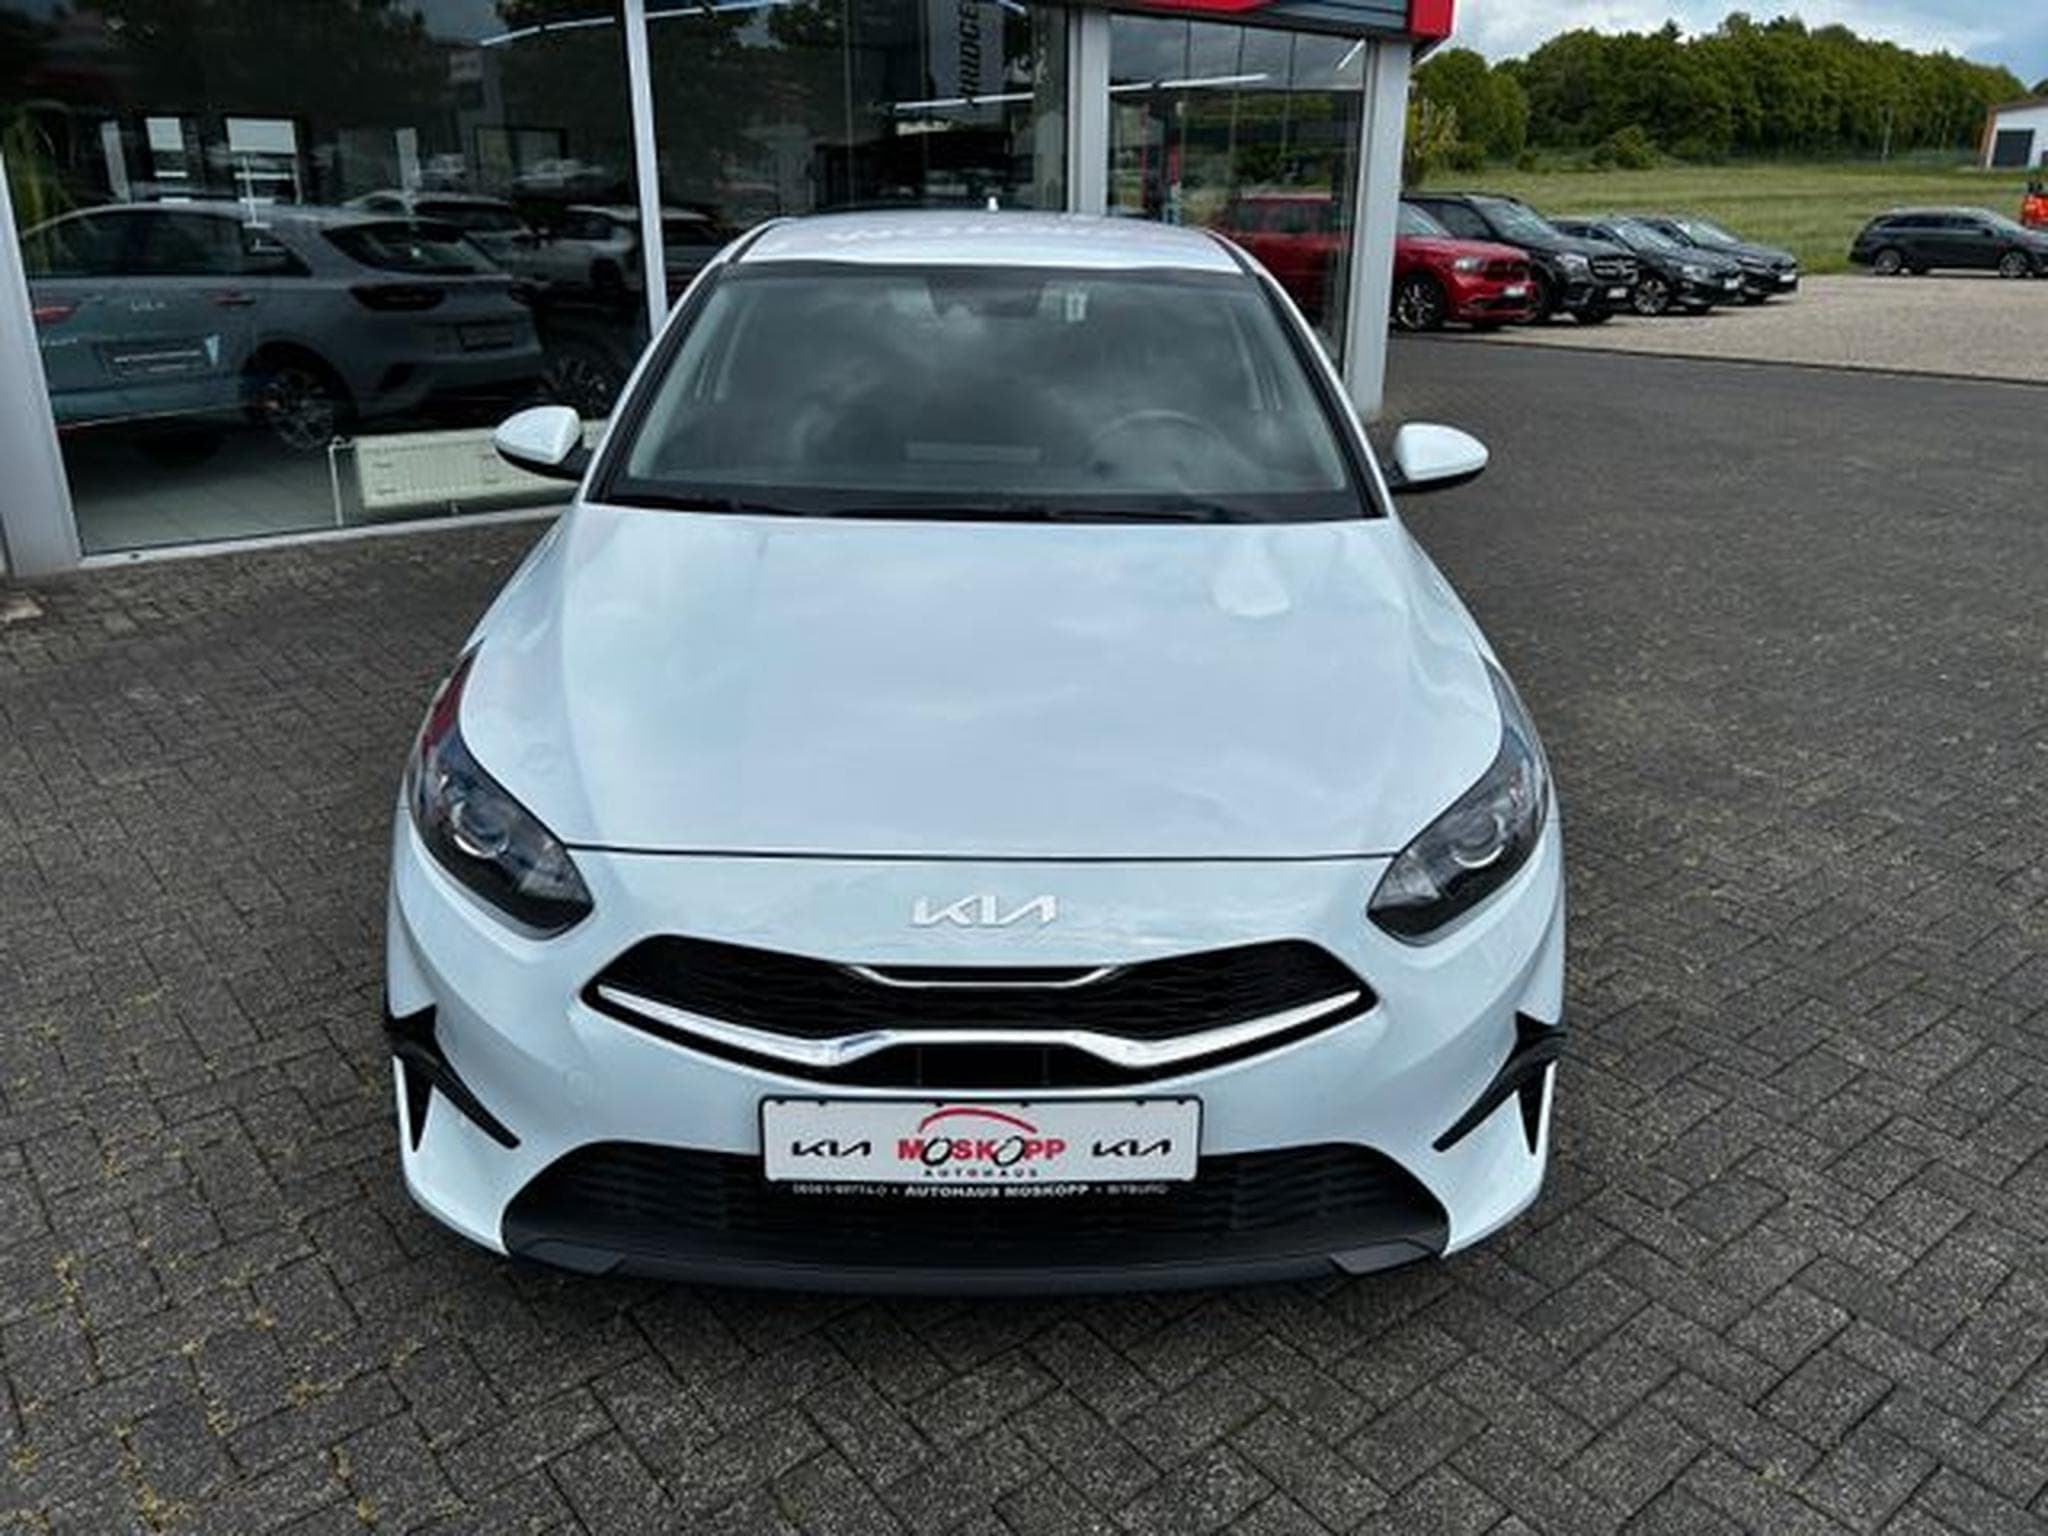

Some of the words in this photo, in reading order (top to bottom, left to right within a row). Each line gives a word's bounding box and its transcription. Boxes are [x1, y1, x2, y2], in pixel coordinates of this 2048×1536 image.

[912, 895, 1056, 928] KIA
[792, 1139, 871, 1157] KIA
[897, 1135, 1066, 1167] MOSKOPP
[1092, 1138, 1171, 1157] KIA
[922, 1168, 1040, 1178] AUTOHAUS
[904, 1186, 1000, 1198] AUTOHAUS
[1004, 1185, 1089, 1198] MOSKOPP
